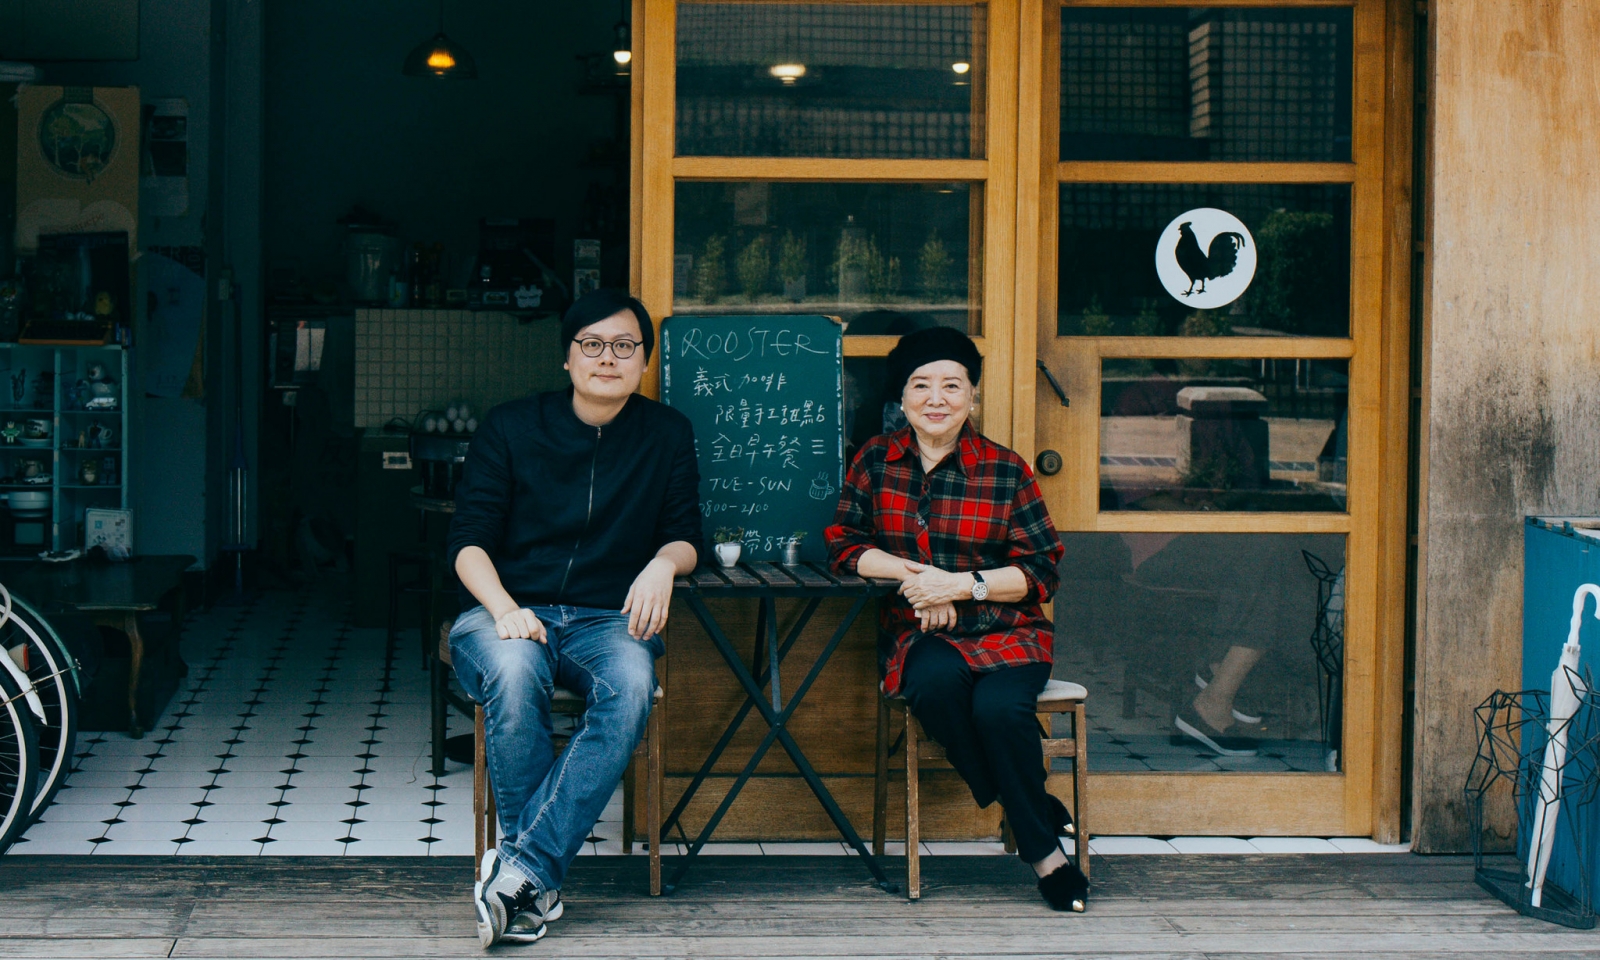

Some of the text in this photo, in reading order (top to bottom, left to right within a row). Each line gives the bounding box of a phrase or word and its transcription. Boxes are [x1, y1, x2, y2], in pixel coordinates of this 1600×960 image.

[681, 327, 829, 361] ROOSTER
[715, 399, 825, 427] 限量手工甜點
[711, 433, 801, 471] 全日早午餐
